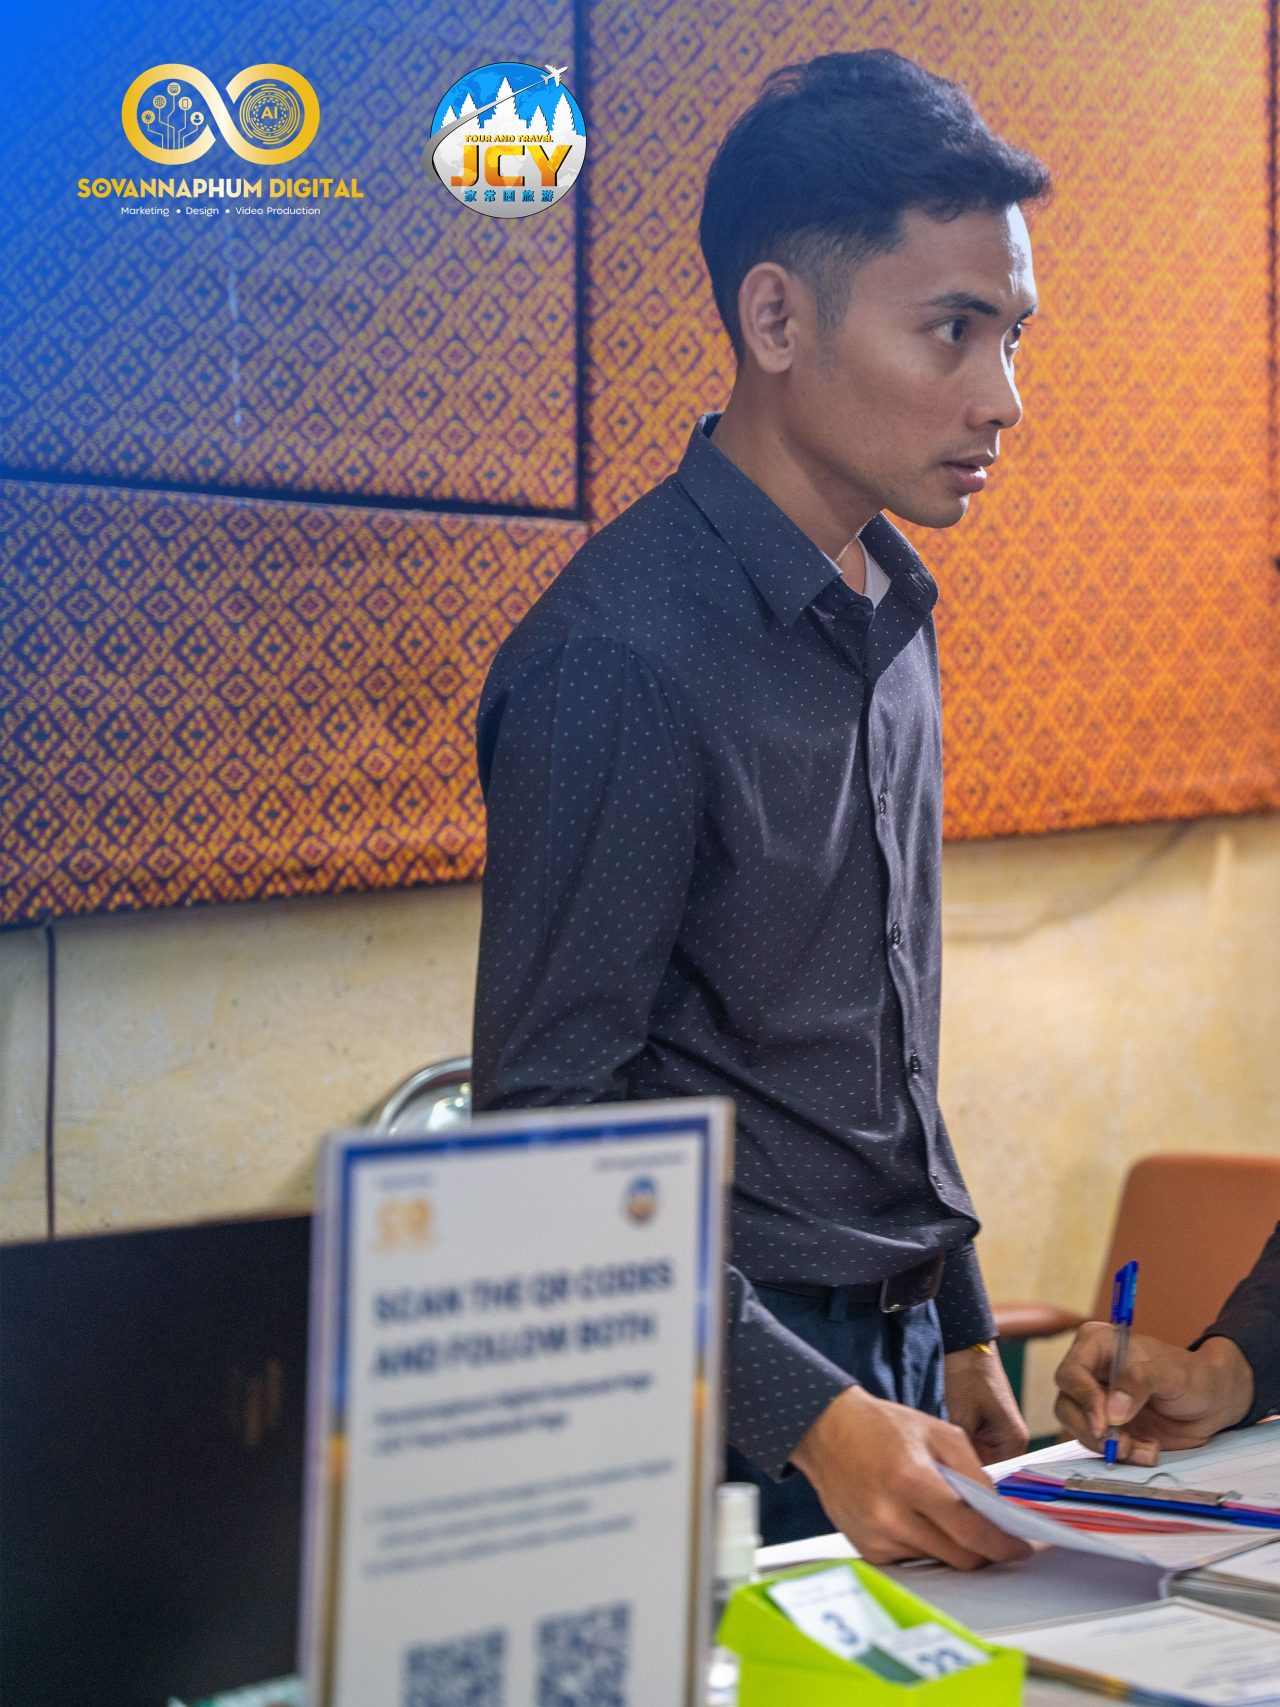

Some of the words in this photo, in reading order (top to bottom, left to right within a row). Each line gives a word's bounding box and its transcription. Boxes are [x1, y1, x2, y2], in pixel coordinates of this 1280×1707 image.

[470, 1277, 523, 1312] THE
[577, 1256, 674, 1301] CODES
[373, 1334, 438, 1379] AND
[448, 1323, 570, 1368] FOLLOW
[576, 1311, 657, 1348] BOTH
